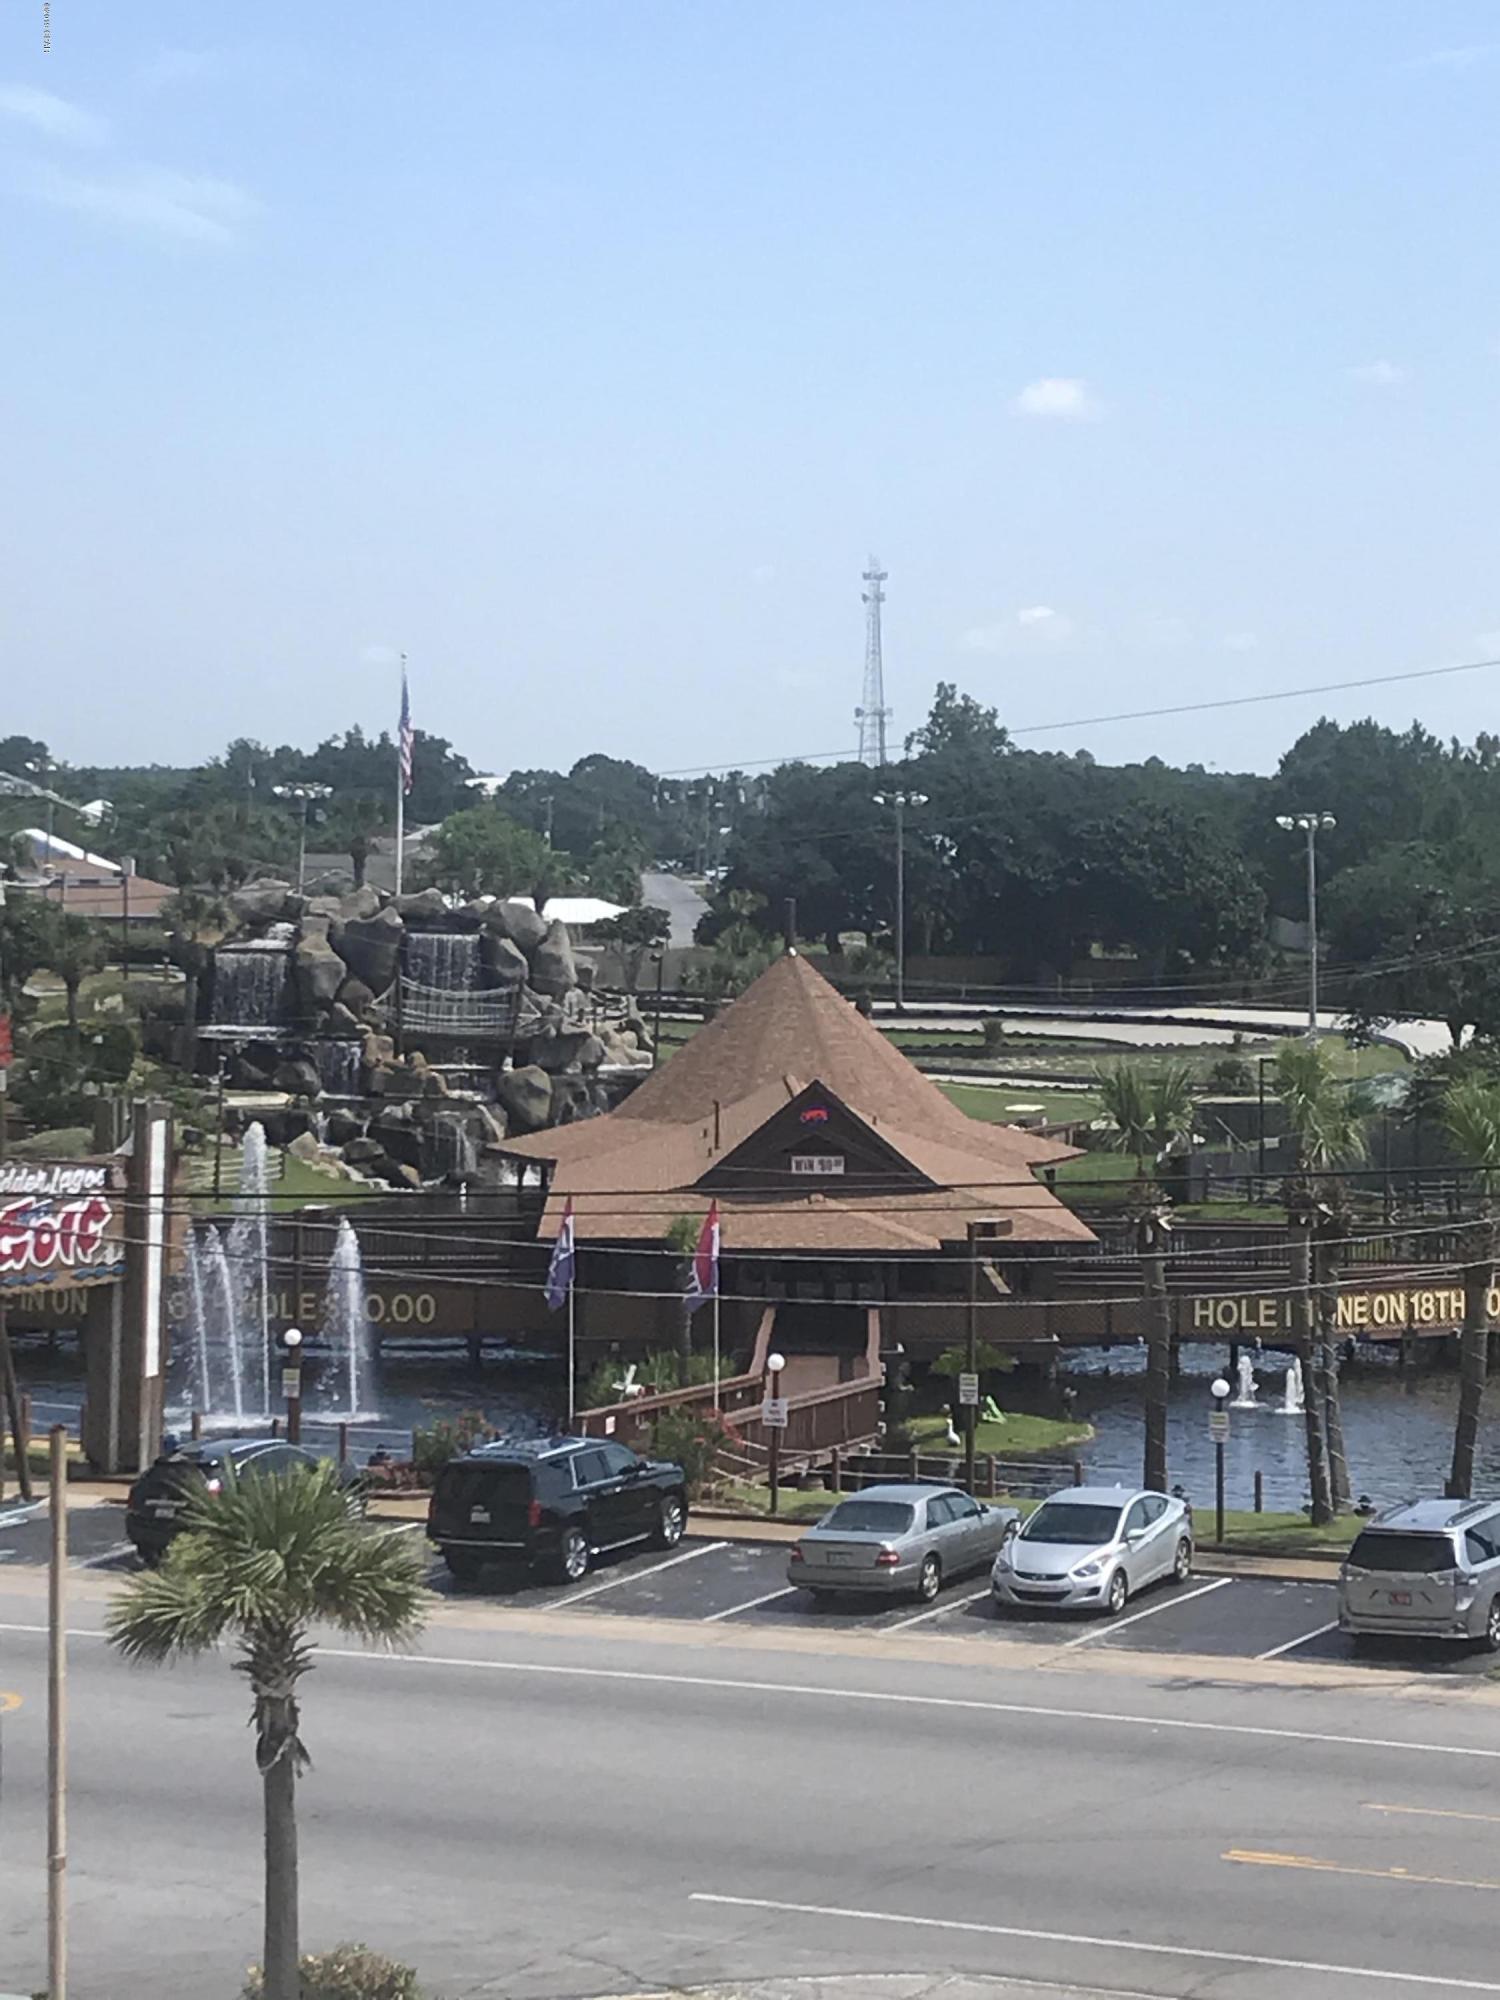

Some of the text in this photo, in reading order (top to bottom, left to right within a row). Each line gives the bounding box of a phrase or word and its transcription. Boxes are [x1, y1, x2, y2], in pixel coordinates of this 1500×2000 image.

[1193, 1298, 1277, 1328] HOLE
[1319, 1294, 1370, 1327] NE
[1373, 1292, 1405, 1324] ON
[1410, 1288, 1466, 1321] 18TH
